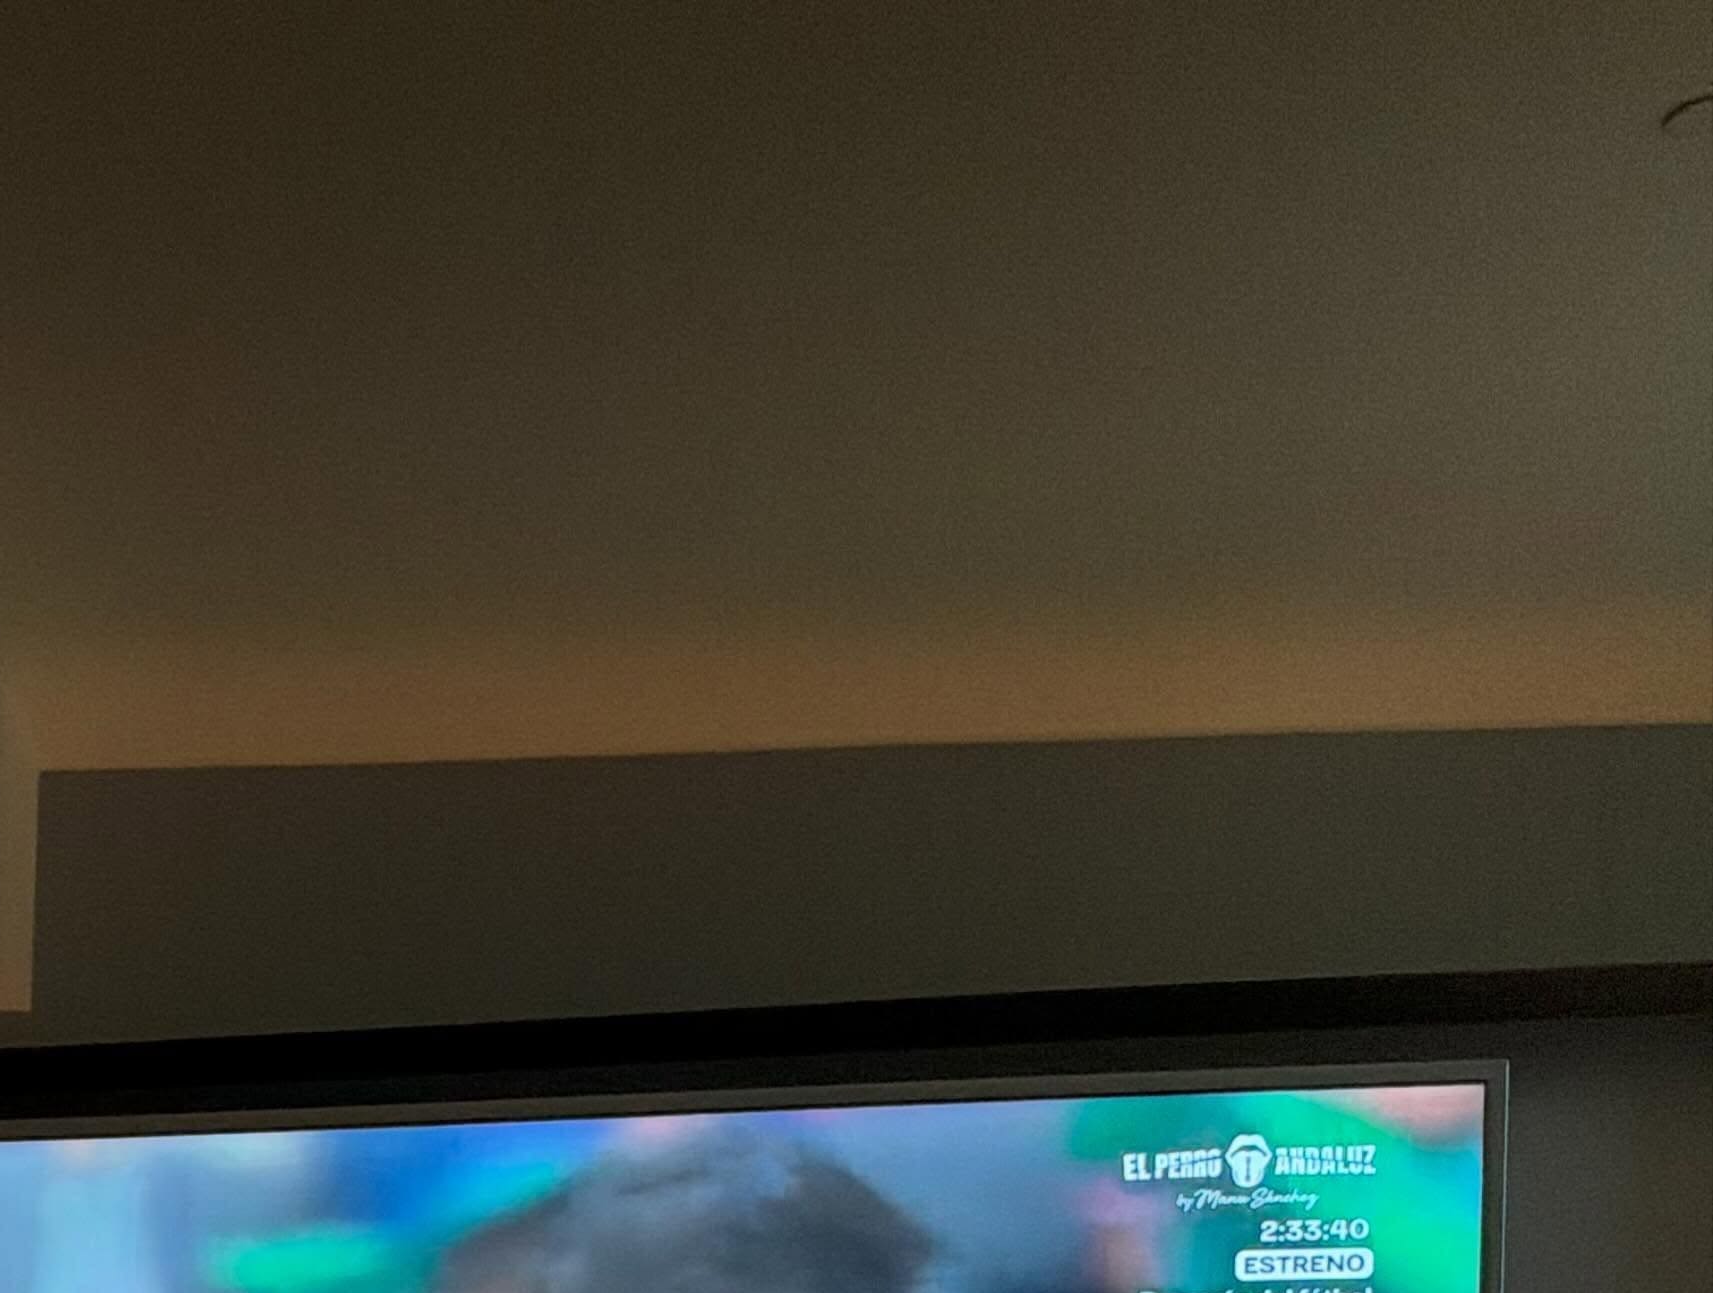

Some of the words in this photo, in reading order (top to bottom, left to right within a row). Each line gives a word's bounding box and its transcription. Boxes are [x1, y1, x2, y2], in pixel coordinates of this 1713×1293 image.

[1122, 1153, 1151, 1181] EL
[1154, 1147, 1222, 1179] PERRO
[1274, 1144, 1377, 1176] ANDALUZ
[1259, 1218, 1370, 1242] 2:33:40
[1244, 1254, 1365, 1274] ESTRENO
